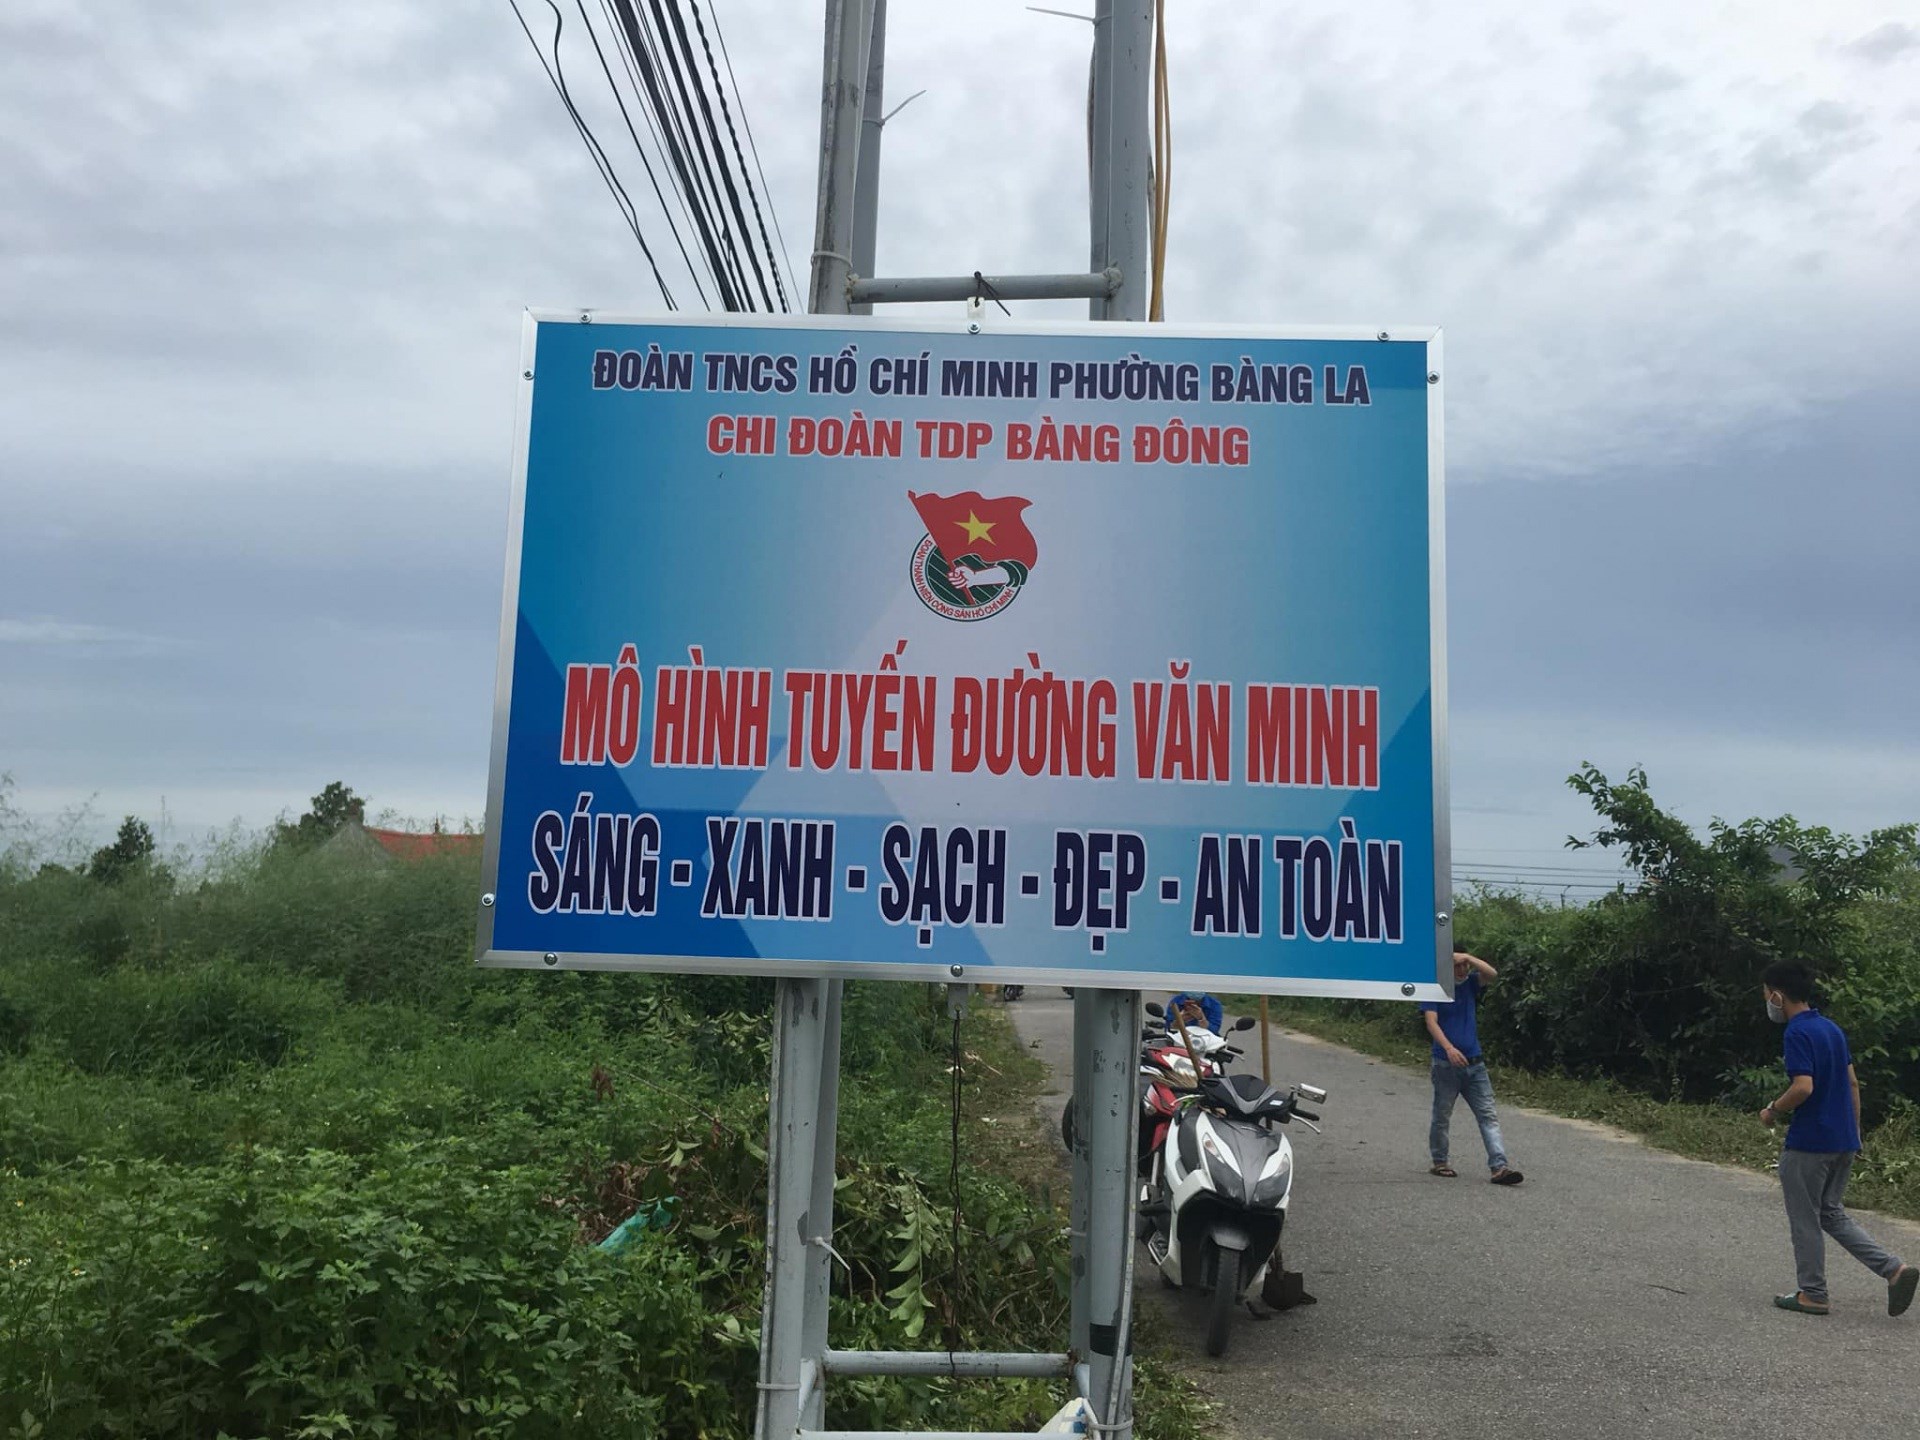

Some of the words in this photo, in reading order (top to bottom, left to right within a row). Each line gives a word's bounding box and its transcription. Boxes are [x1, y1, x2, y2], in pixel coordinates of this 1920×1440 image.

[594, 344, 693, 391] ĐOÀN
[704, 354, 798, 394] TNCS
[808, 345, 858, 395] HỒ
[869, 351, 931, 397] CHÍ
[941, 360, 1037, 398] MINH
[1050, 353, 1199, 402] PHƯỜNG
[1211, 357, 1313, 404] BÀNG
[1324, 365, 1371, 405] LA
[706, 415, 776, 456] CHI
[788, 411, 902, 458] ĐOÀN
[915, 420, 993, 460] TDP
[1006, 416, 1120, 463] BÀNG
[1133, 417, 1250, 466] ĐÔNG
[561, 644, 641, 766] MÔ
[652, 645, 772, 768] HÌNH
[785, 640, 937, 772] TUYẾN
[951, 652, 1117, 778] ĐƯỜNG
[1133, 660, 1231, 782] VĂN
[1247, 686, 1379, 788] MINH
[529, 792, 660, 915] SÁNG
[672, 861, 692, 886] -
[701, 817, 835, 920] XANH
[846, 866, 867, 891] -
[880, 821, 1007, 947] SẠCH
[1021, 873, 1040, 897] -
[1053, 829, 1146, 953] ĐẸP
[1160, 878, 1180, 902] -
[1192, 834, 1262, 937] AN
[1275, 817, 1402, 943] TOÀN
